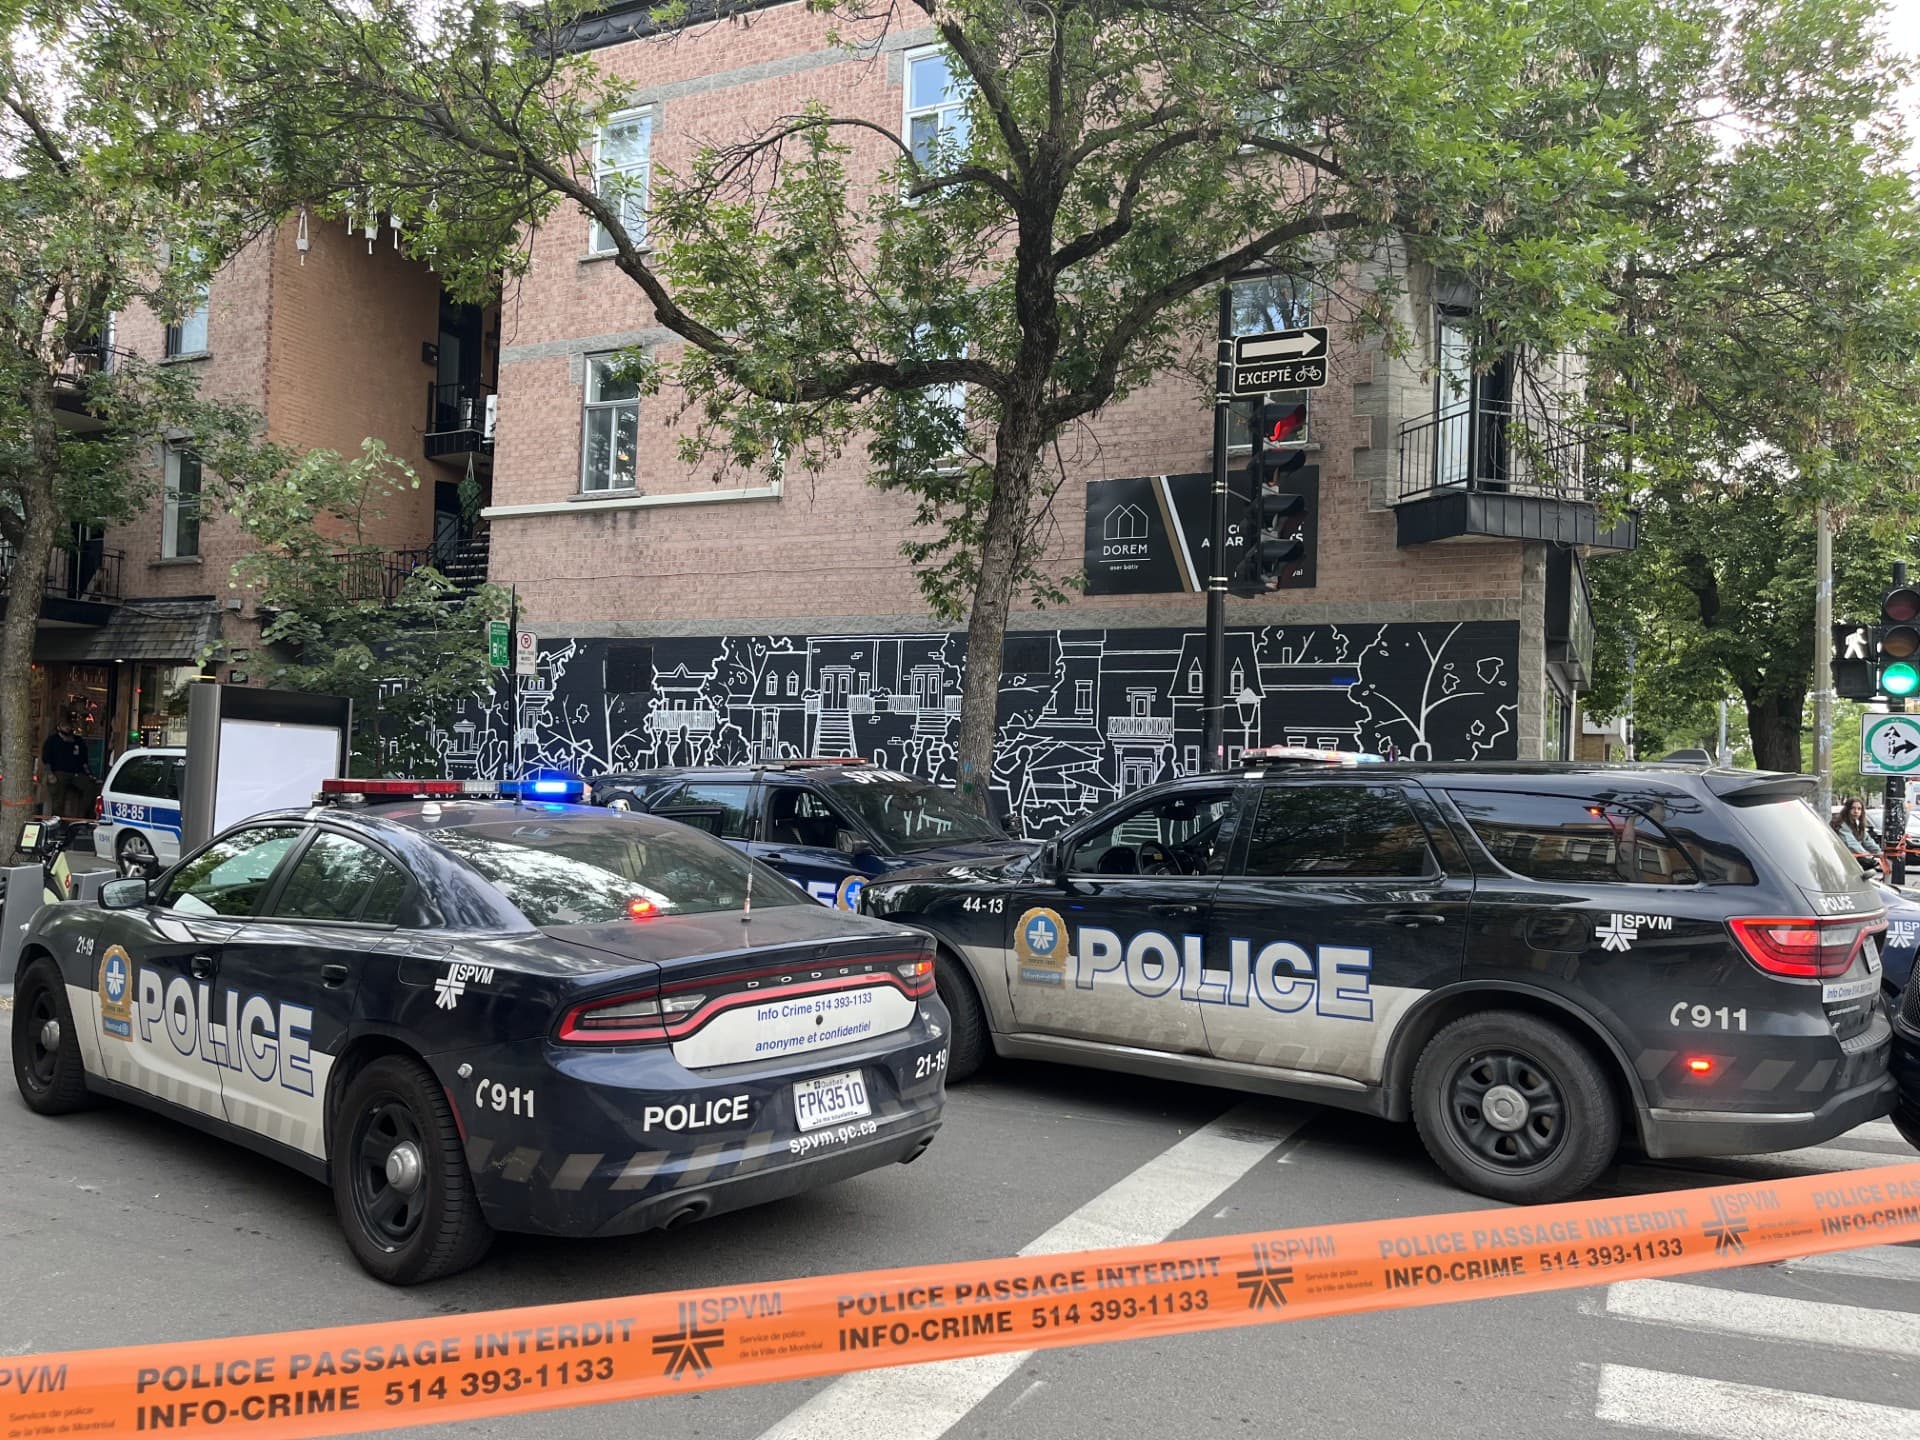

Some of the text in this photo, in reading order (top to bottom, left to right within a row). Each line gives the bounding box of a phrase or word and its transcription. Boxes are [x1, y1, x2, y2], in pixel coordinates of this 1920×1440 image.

[1238, 366, 1292, 386] EXCEPTÉ
[1103, 544, 1148, 556] DOREM
[115, 803, 145, 821] 38-85
[962, 896, 1004, 914] 44-13
[1819, 895, 1856, 913] POLICE
[1624, 914, 1673, 931] SPVM
[75, 935, 95, 957] 21-19
[457, 964, 495, 985] SPVM
[747, 965, 873, 989] DODGE
[1075, 926, 1374, 1022] POLICE
[757, 992, 873, 1022] Info Crime 514 393-1133
[1690, 1004, 1747, 1032] 911
[138, 966, 315, 1098] POLICE
[755, 1021, 871, 1052] anonyme et confidentiel
[915, 1048, 947, 1079] 21-19
[491, 1082, 535, 1119] 911
[643, 1094, 750, 1133] POLICE
[798, 1082, 865, 1119] FPK3510
[789, 1120, 877, 1156] spvm.qc.ca
[1723, 1188, 1781, 1214] SPVM
[1812, 1184, 1884, 1211] POLICE
[1378, 1207, 1689, 1260] POLICE PASSAGE INTERDIT
[1821, 1204, 1920, 1236] INFO-CRIM
[1272, 1233, 1337, 1263] SPVM
[1384, 1255, 1526, 1290] INFO-CRIME
[1540, 1249, 1580, 1273] 514
[1587, 1238, 1684, 1268] 393-1133
[837, 1256, 1222, 1318] POLICE PASSAGE INTERDIT
[701, 1291, 783, 1324] SPVM
[839, 1289, 1210, 1352] INFO-CRIME 514 393-1133
[136, 1317, 638, 1394] POLICE PASSAGE INTERDIT
[136, 1356, 615, 1432] INFO-CRIME 514 393-1133
